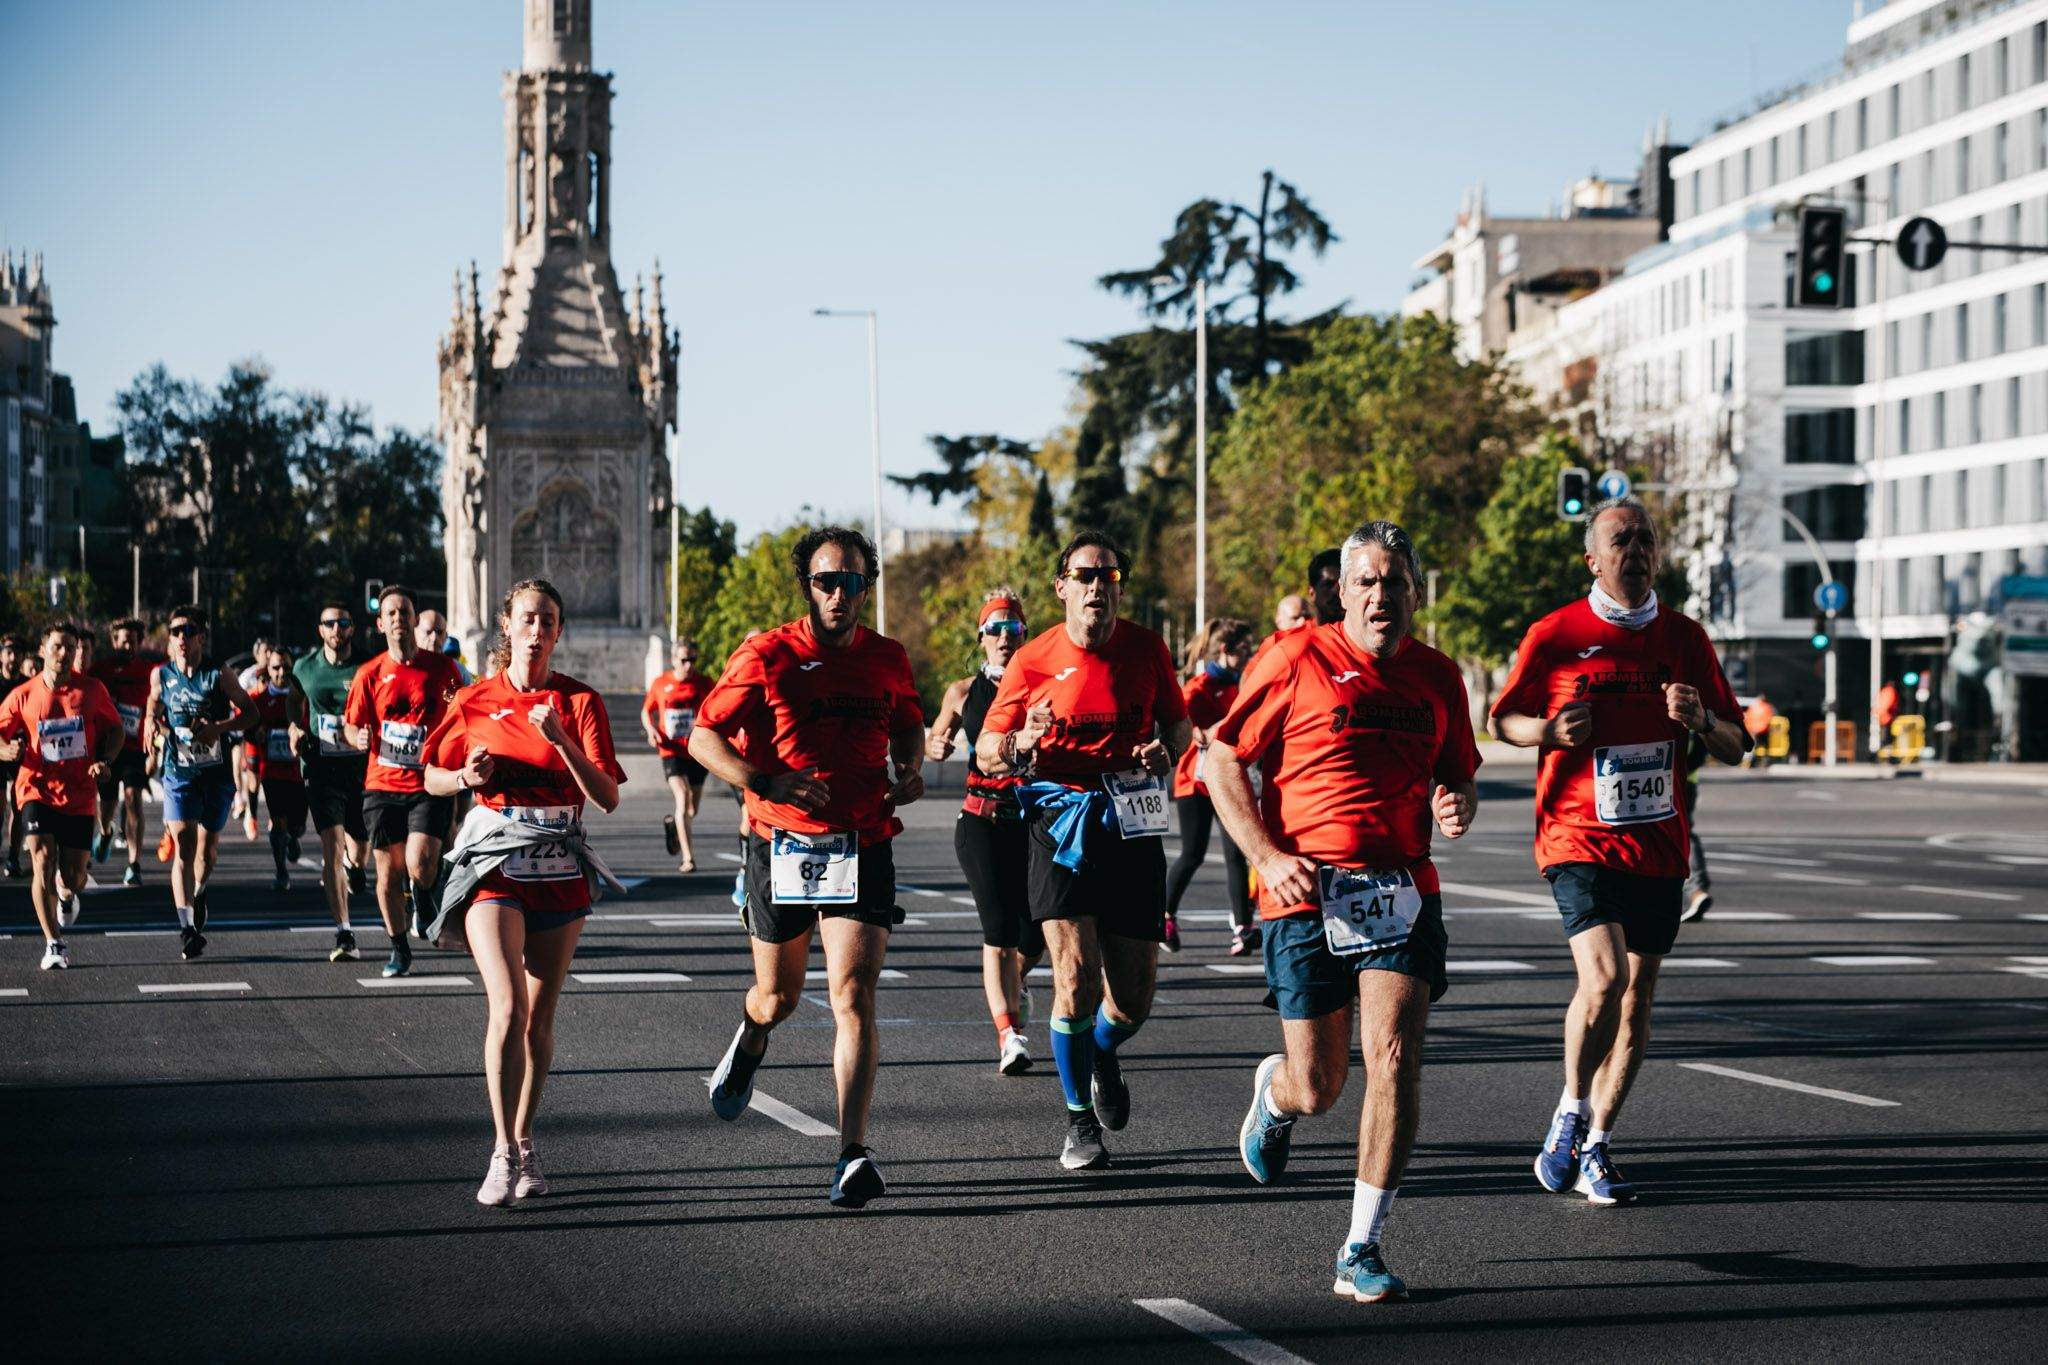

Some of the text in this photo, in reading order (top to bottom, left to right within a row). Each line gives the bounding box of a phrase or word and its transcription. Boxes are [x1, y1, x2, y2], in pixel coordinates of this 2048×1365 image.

[50, 736, 73, 749] 147
[389, 741, 418, 756] 1089
[1612, 776, 1665, 801] 1540
[1127, 795, 1162, 816] 1188
[519, 841, 569, 859] 1223
[801, 860, 828, 881] 82
[1350, 894, 1395, 924] 547
